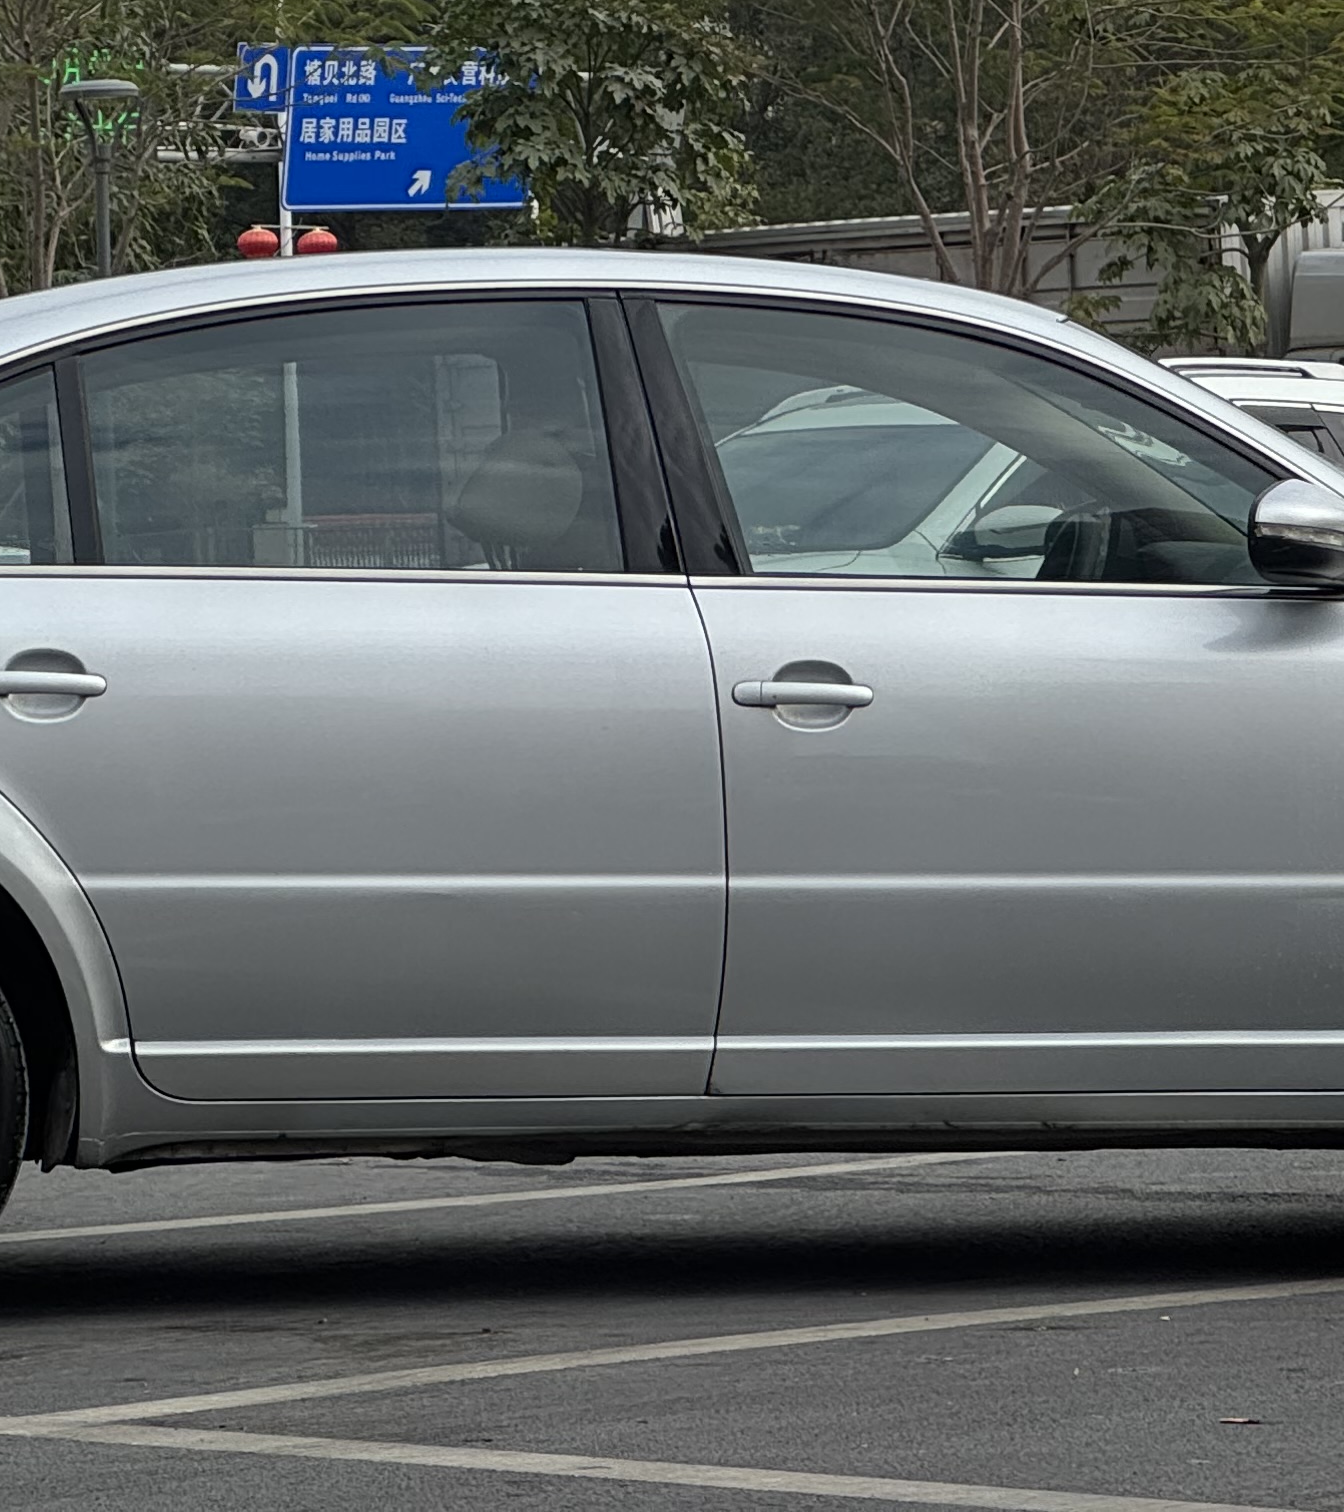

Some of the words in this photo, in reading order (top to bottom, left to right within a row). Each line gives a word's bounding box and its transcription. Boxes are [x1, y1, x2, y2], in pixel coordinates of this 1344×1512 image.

[304, 59, 377, 86] 塘贝北路
[299, 116, 408, 144] 居家用品园区
[304, 150, 331, 162] Home
[332, 150, 372, 163] Supplies
[373, 149, 396, 161] Park
